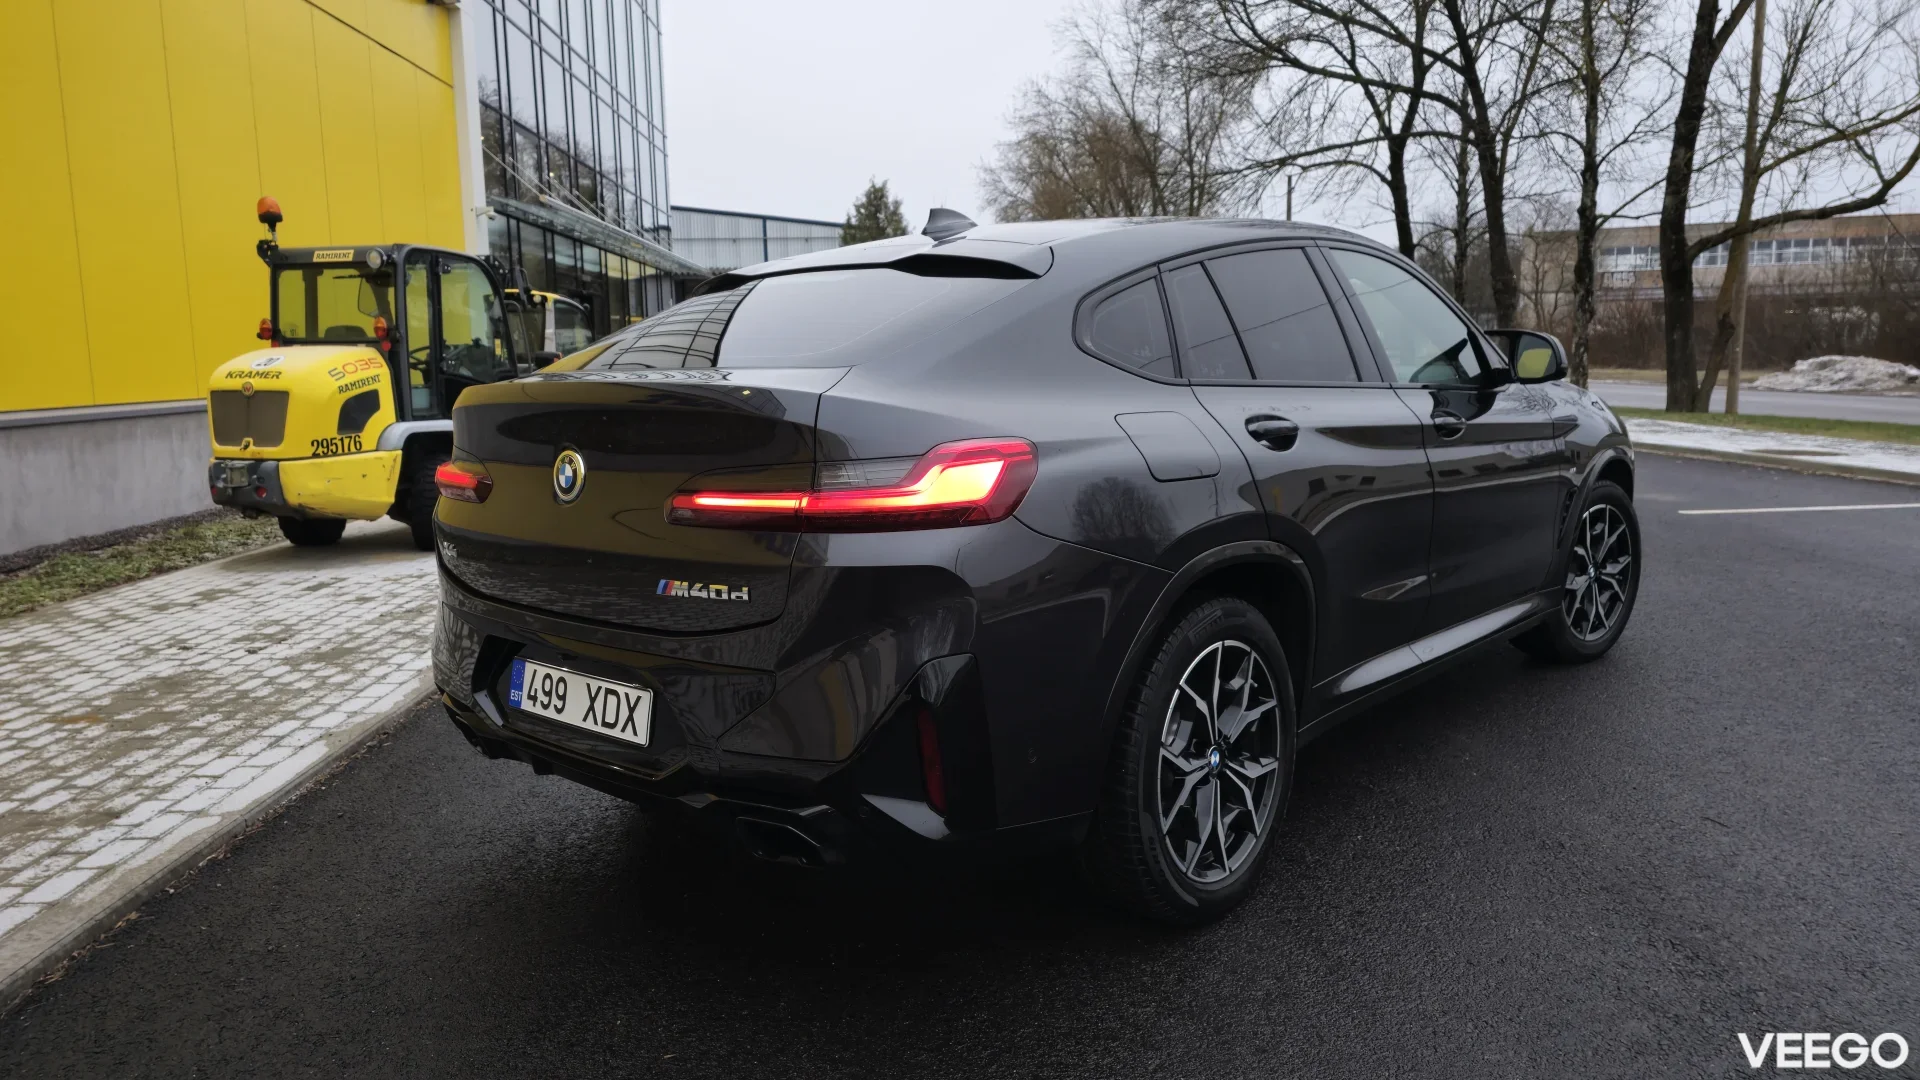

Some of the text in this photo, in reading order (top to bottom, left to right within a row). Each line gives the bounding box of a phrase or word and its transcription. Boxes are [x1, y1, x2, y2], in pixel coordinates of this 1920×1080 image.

[225, 371, 282, 379] KRAMER
[328, 357, 383, 381] 5035
[337, 374, 381, 394] RAMIRENT
[311, 434, 362, 457] 295176
[671, 580, 749, 600] M40d
[510, 690, 522, 702] EST
[527, 669, 642, 737] 499 XDX
